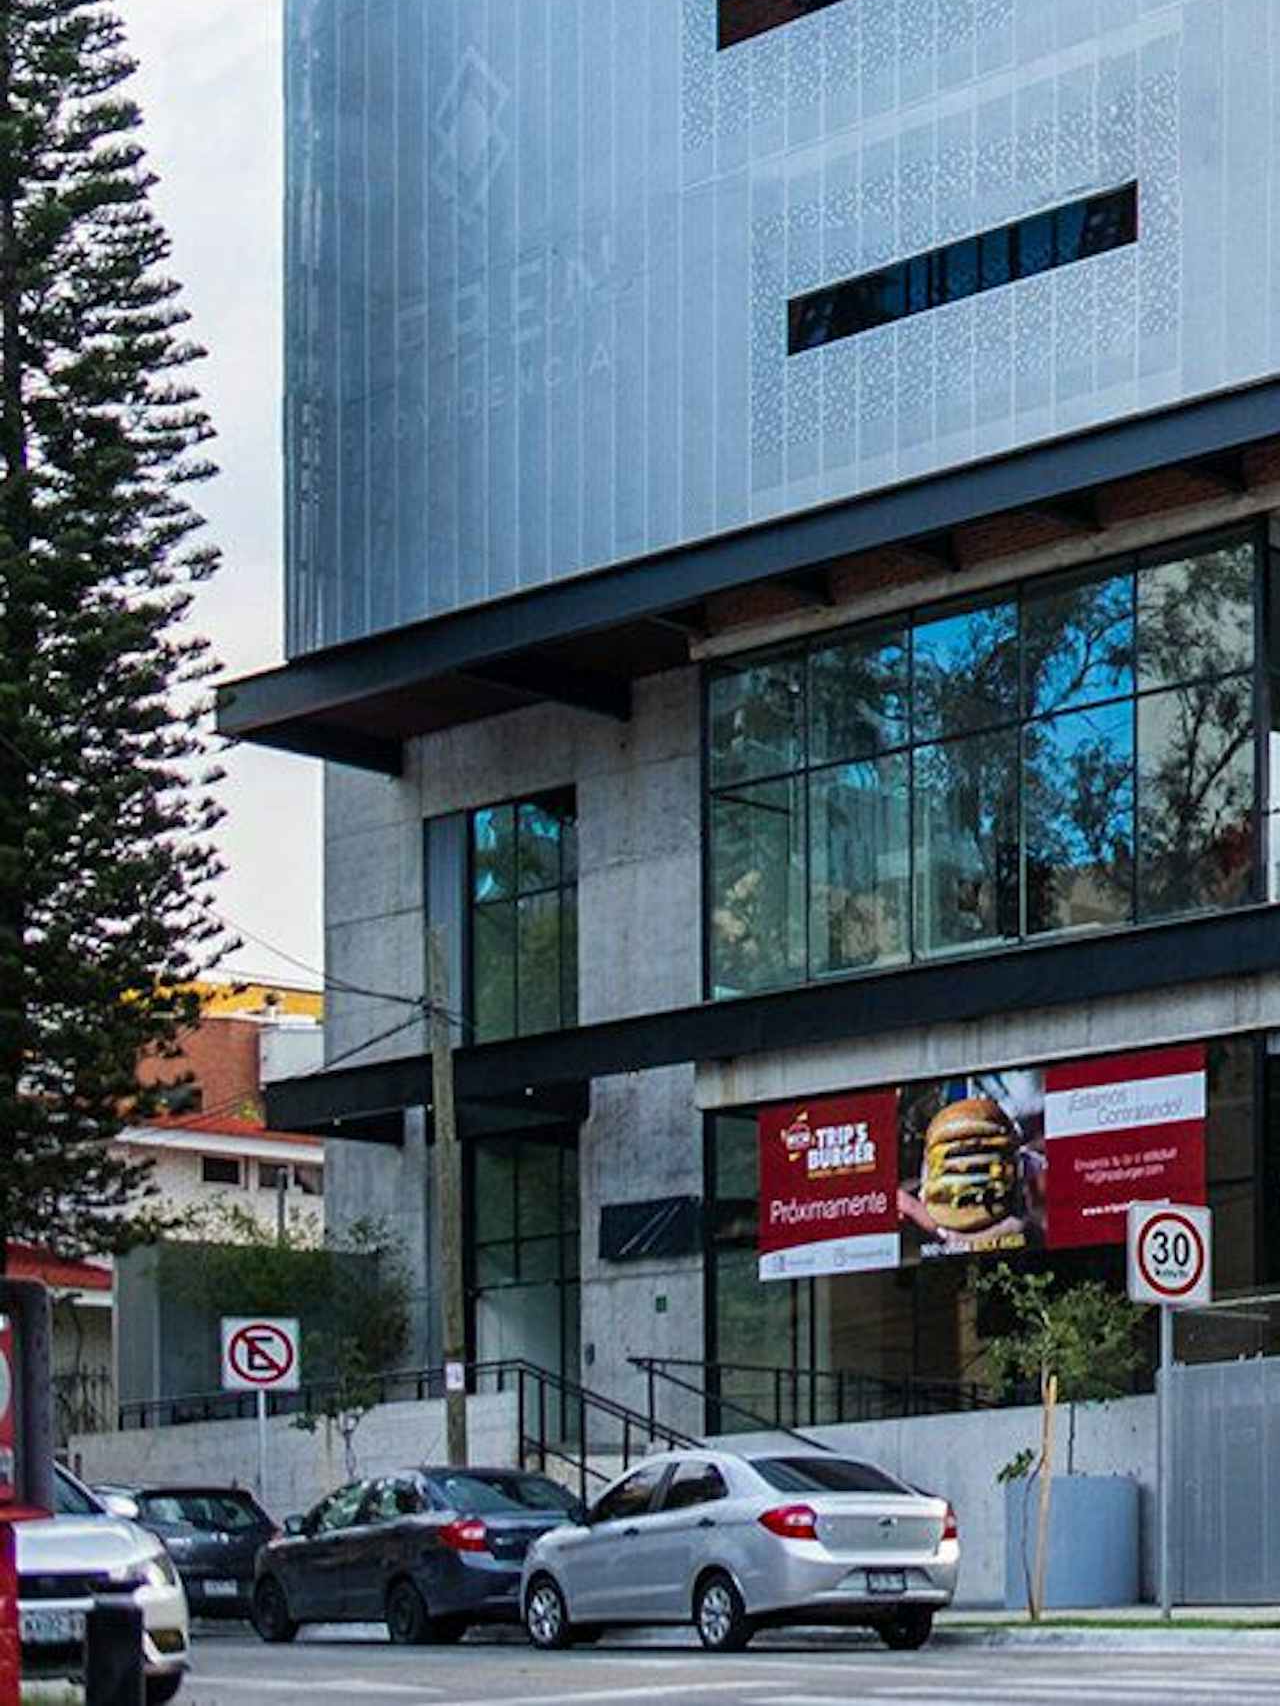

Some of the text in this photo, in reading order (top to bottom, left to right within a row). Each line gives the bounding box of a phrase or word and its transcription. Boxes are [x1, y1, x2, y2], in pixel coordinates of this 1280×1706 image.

[807, 1141, 877, 1170] BURGER
[769, 1191, 888, 1225] Próximamente
[1152, 1231, 1190, 1266] 30
